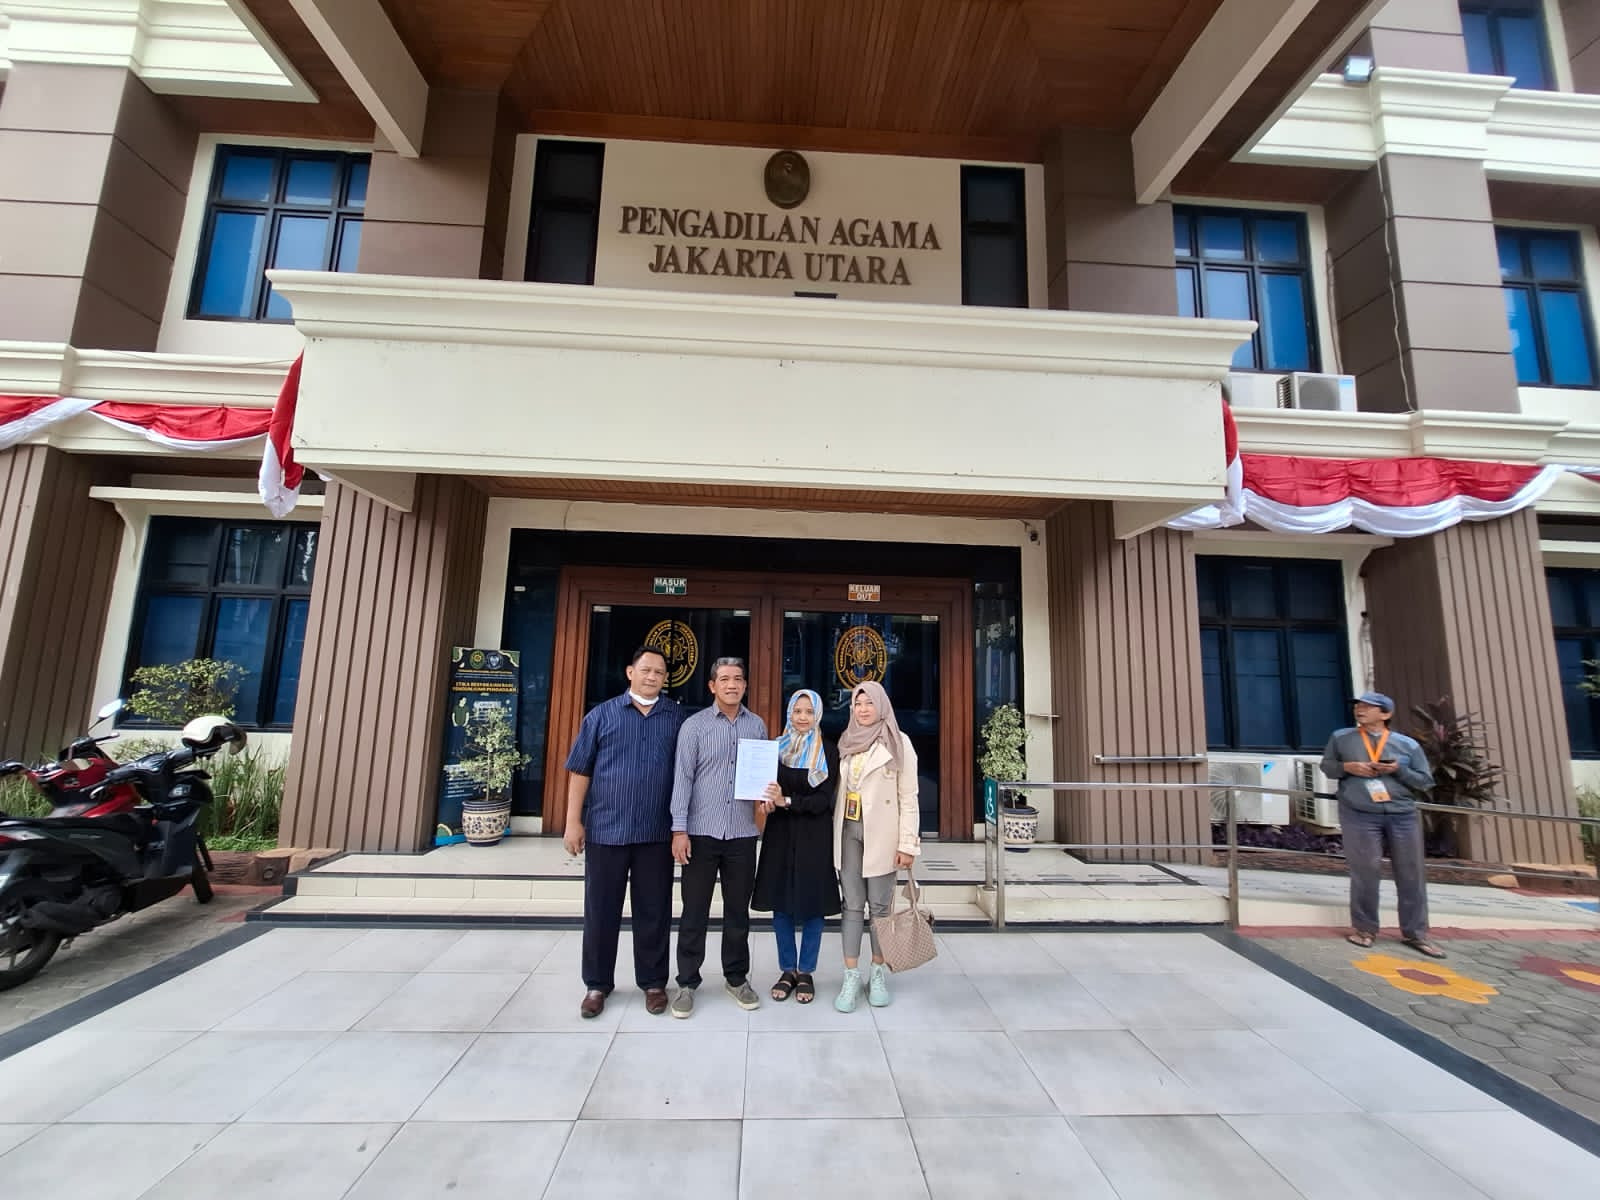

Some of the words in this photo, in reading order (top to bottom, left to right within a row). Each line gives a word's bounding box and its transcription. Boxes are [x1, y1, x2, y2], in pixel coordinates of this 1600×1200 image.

[618, 205, 820, 244] PENGADILAN
[828, 217, 942, 250] AGAMA
[648, 244, 794, 280] JAKARTA
[803, 252, 911, 286] UTARA
[655, 577, 687, 586] MASUK
[664, 585, 675, 594] IN
[856, 592, 872, 601] OUT
